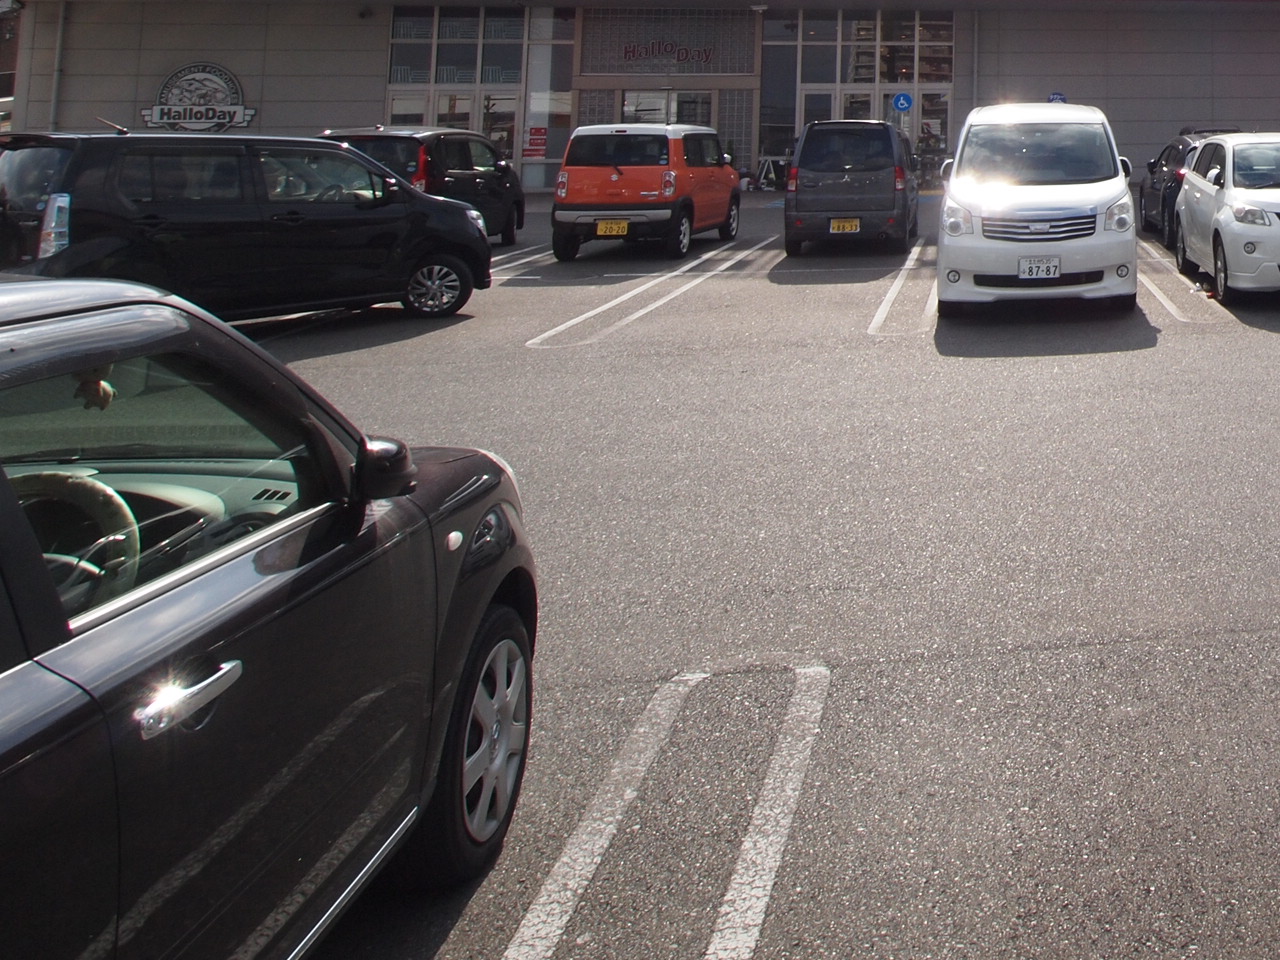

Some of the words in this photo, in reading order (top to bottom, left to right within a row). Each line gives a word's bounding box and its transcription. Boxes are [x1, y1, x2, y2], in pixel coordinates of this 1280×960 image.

[623, 40, 677, 61] Hallo
[676, 46, 713, 65] Day
[159, 107, 237, 124] HalloDay
